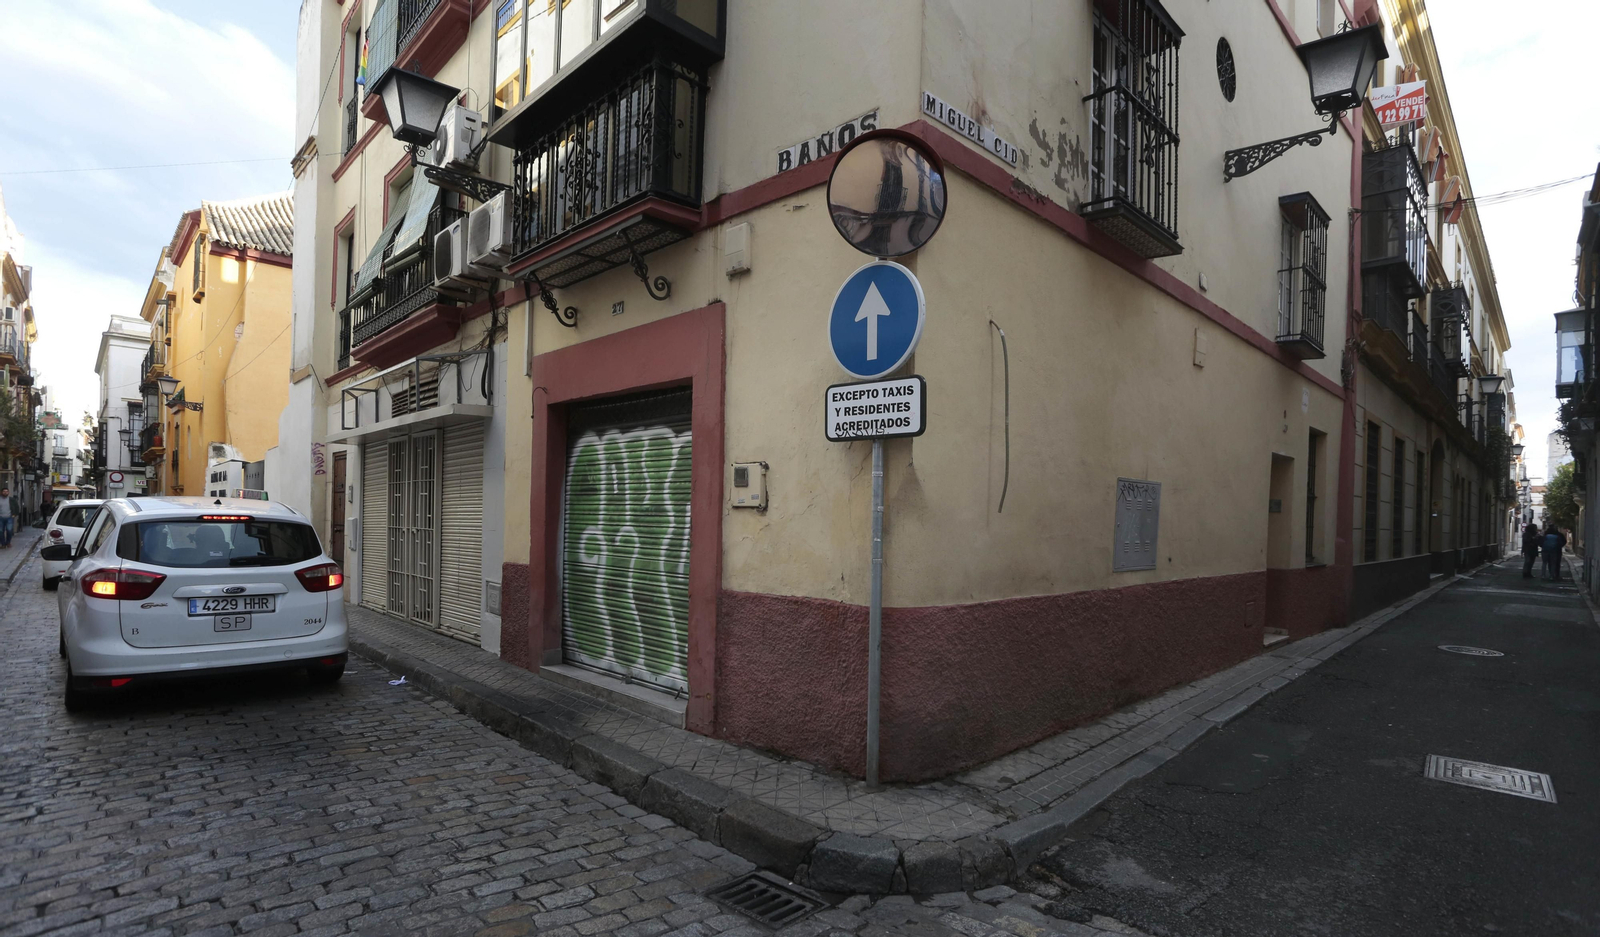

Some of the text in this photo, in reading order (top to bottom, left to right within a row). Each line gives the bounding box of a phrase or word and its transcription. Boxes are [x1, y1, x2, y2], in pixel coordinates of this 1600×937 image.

[1395, 96, 1423, 108] VENDE
[1376, 105, 1423, 123] 4 22 99 71
[926, 94, 1017, 164] MIGUEL CID
[778, 111, 877, 173] BAÑOS
[832, 385, 914, 402] EXCEPTO TAXIS
[835, 402, 911, 417] Y RESIDENTES
[835, 417, 911, 432] ACREDITADOS
[202, 597, 269, 612] 4229 HHR
[220, 616, 246, 629] SP
[304, 617, 322, 625] 2044
[131, 627, 139, 635] B
